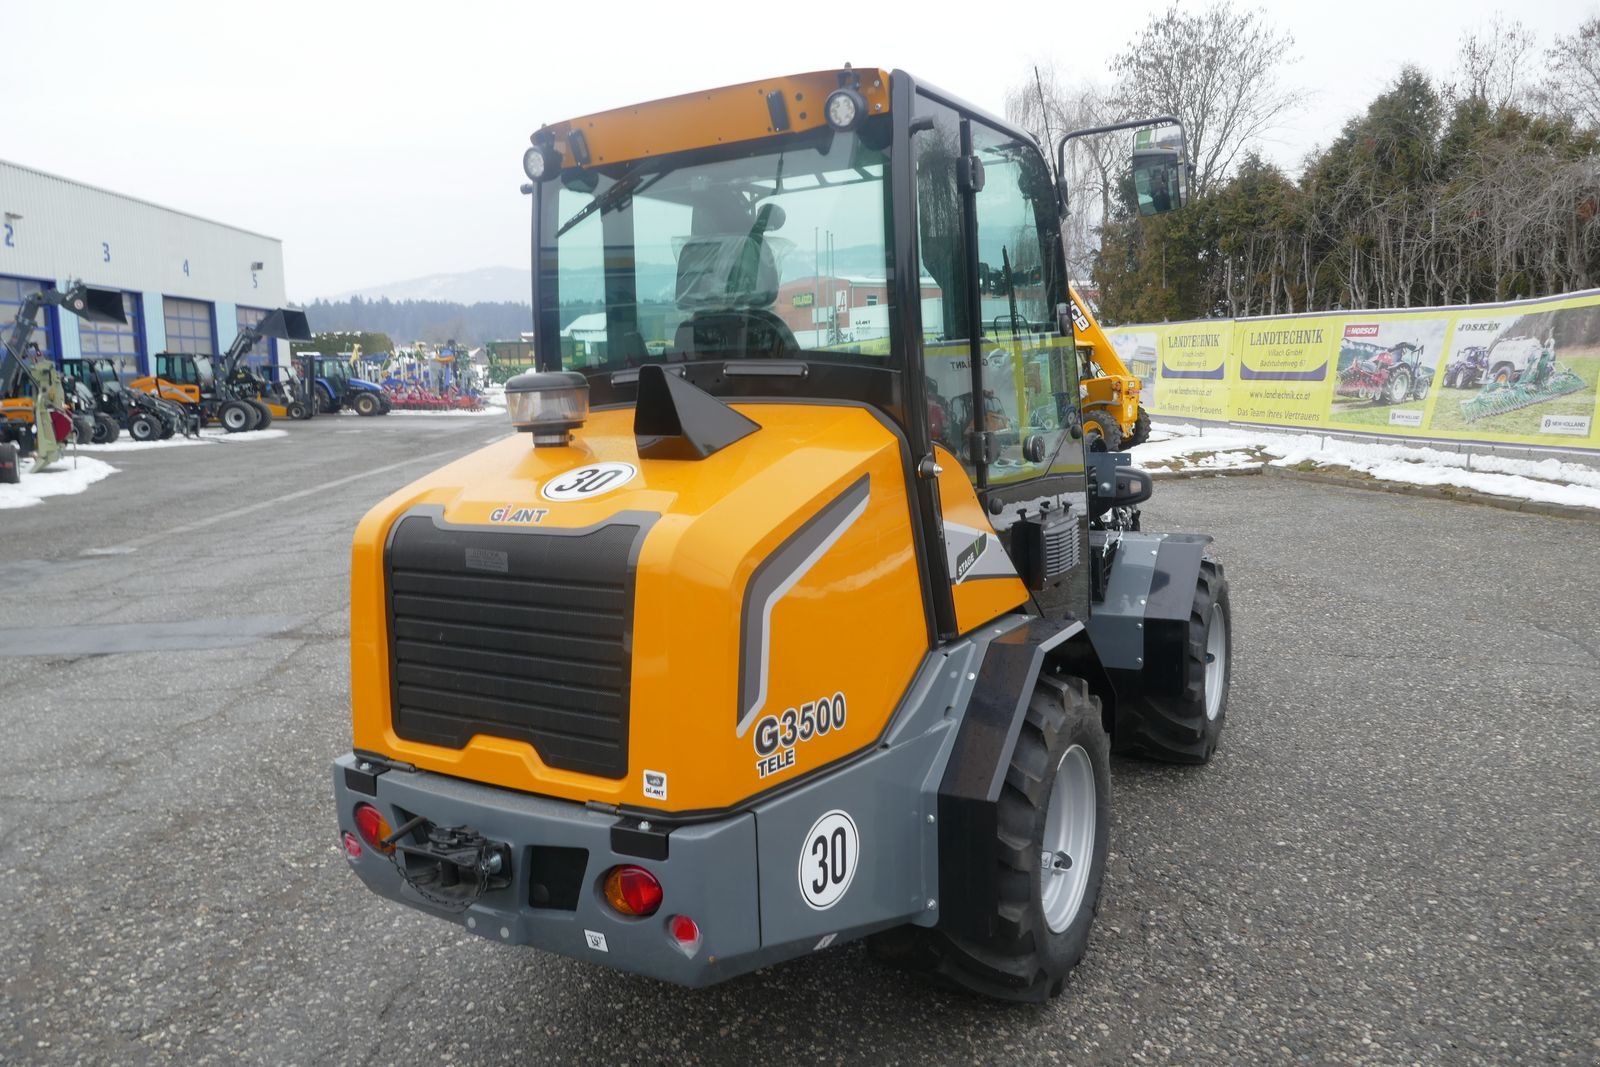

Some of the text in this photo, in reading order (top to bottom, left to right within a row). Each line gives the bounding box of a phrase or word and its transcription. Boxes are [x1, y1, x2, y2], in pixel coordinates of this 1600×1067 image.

[4, 223, 15, 248] 2
[102, 242, 110, 262] 3
[183, 259, 190, 277] 4
[252, 273, 258, 289] 5
[1070, 299, 1091, 332] CB
[1168, 334, 1220, 348] LANDTECHNIK
[1250, 329, 1323, 346] LANDTECHNIK
[1237, 408, 1248, 416] Das
[1250, 408, 1266, 417] Team
[1284, 410, 1320, 421] Vertrauens
[554, 468, 623, 493] 30
[958, 552, 975, 577] STAGE
[754, 691, 847, 757] G3500
[757, 748, 796, 779] TELE
[811, 826, 847, 895] 30
